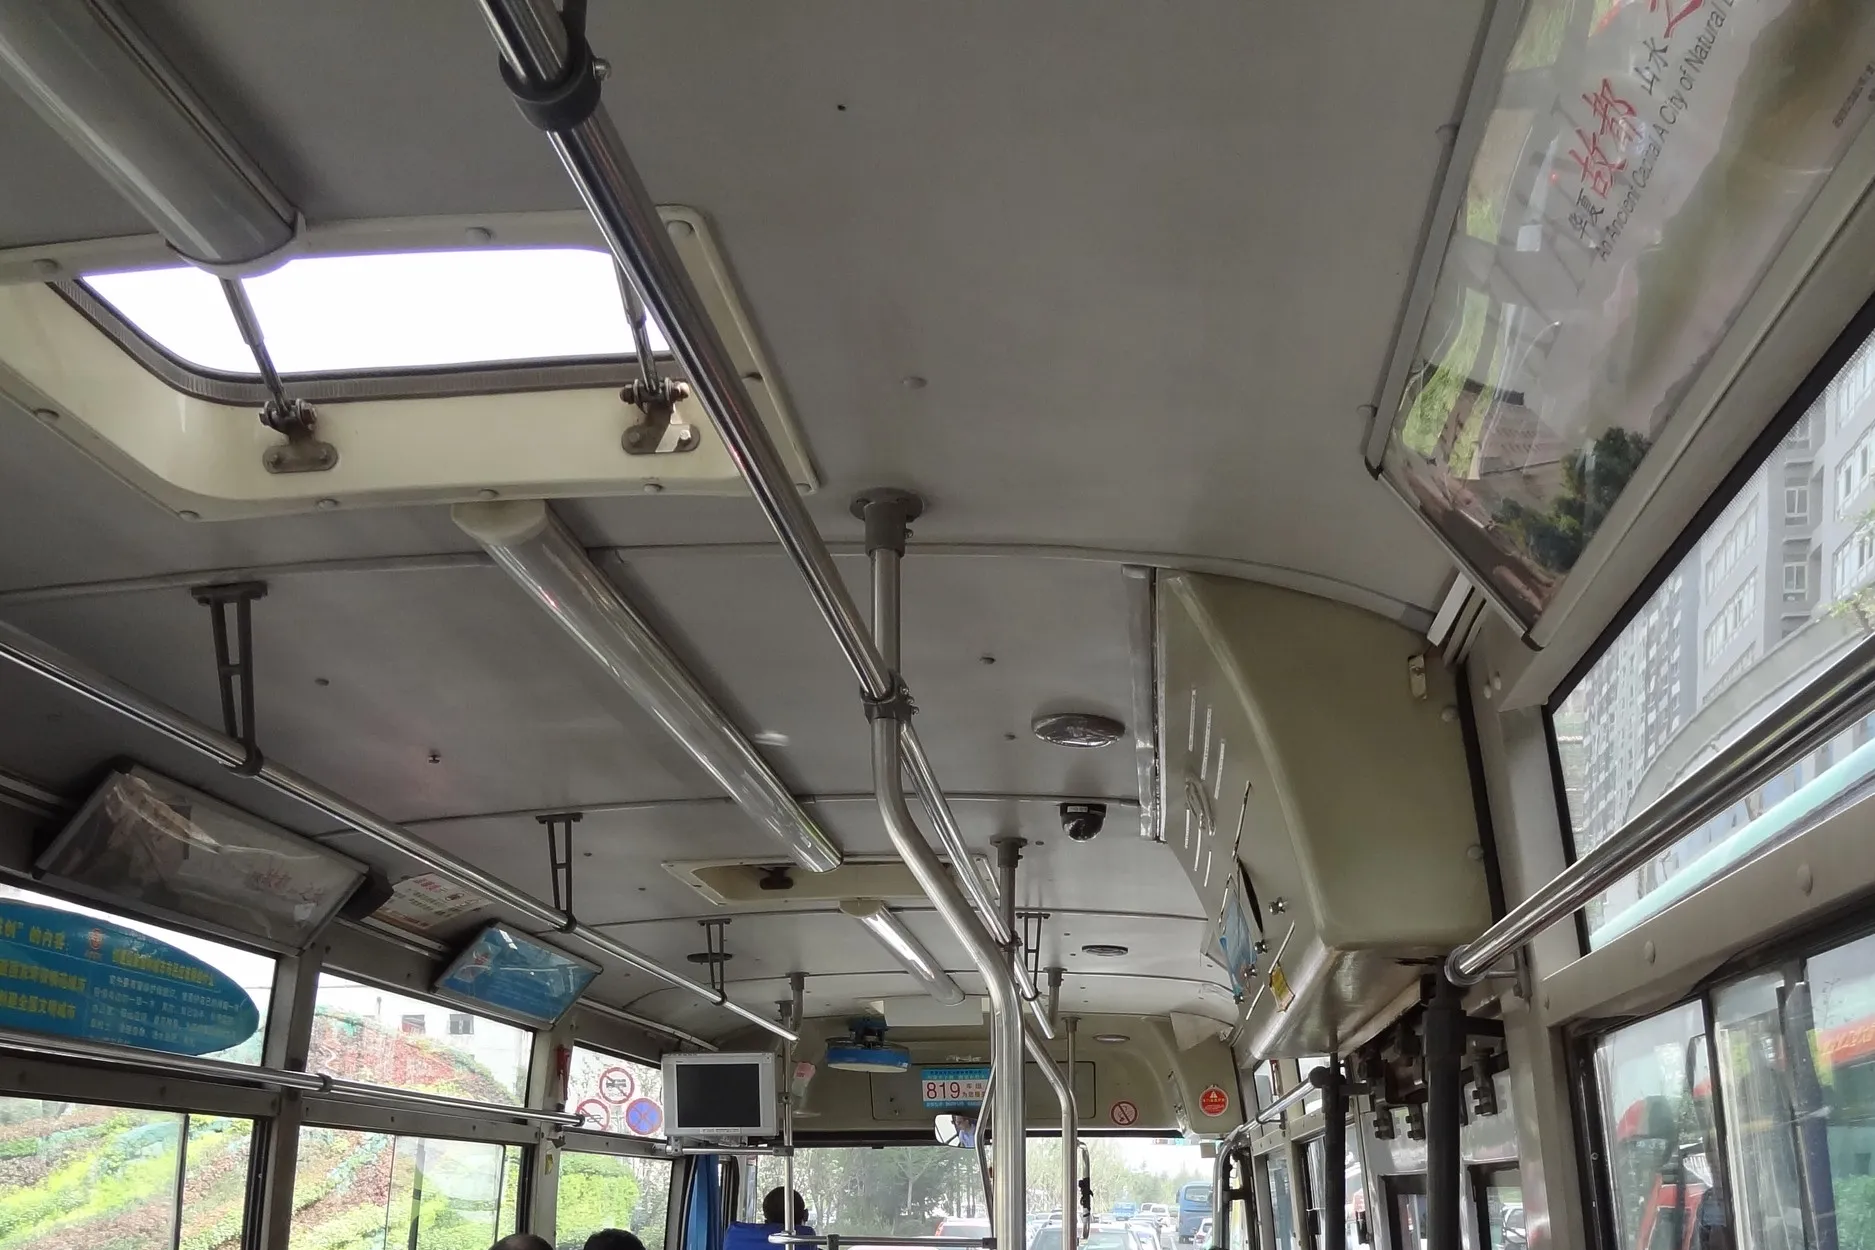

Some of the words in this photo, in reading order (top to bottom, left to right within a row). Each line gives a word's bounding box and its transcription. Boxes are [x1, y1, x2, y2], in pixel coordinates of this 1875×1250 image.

[1684, 0, 1727, 73] Natural
[1680, 63, 1697, 91] of
[1659, 87, 1688, 125] City
[1652, 121, 1670, 144] A
[1595, 237, 1613, 262] An
[926, 1081, 961, 1099] 819
